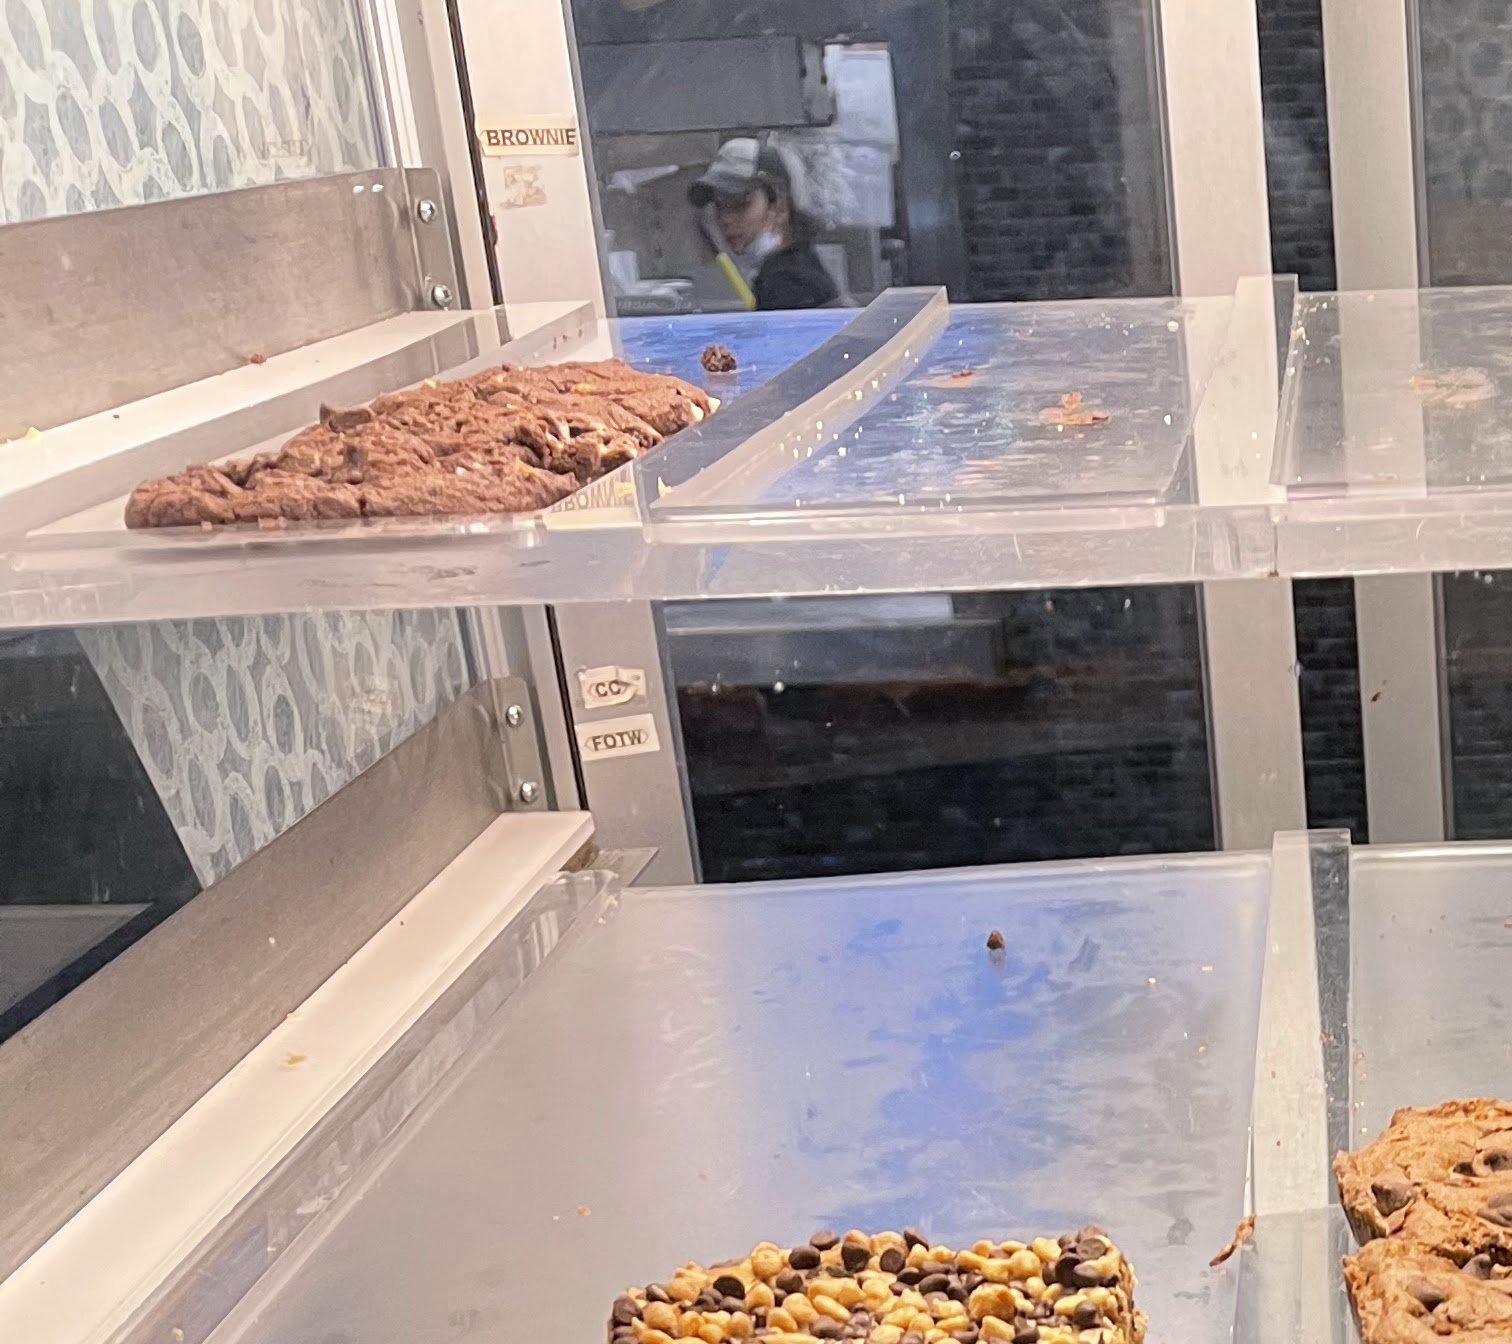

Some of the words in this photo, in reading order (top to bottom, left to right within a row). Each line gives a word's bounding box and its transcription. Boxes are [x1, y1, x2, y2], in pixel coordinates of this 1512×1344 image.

[486, 128, 577, 146] BROWNIE
[595, 680, 621, 697] CC
[592, 729, 642, 752] FOTW
